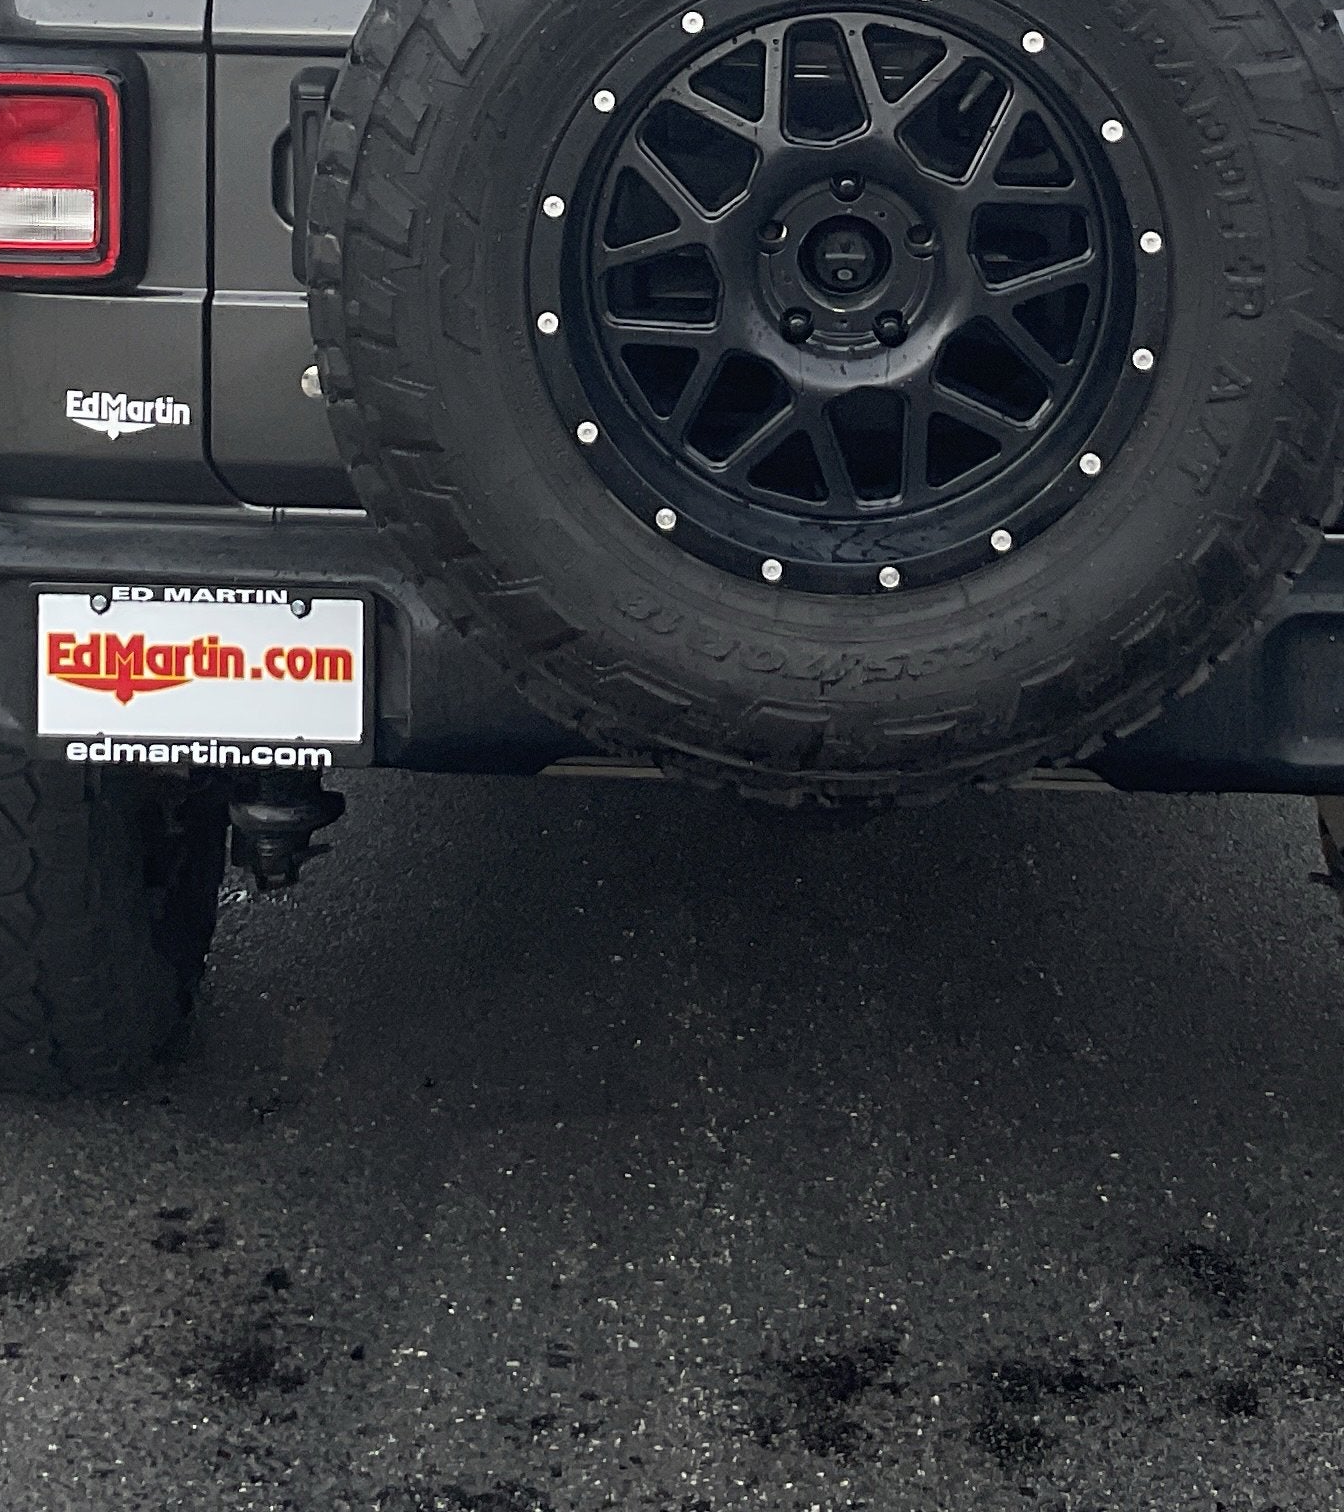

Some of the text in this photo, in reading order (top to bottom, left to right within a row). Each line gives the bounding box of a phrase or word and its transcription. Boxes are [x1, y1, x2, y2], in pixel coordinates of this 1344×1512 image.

[65, 389, 191, 427] EdMartin
[112, 586, 288, 605] ED MARTIN
[47, 632, 354, 683] EdMartin.com
[66, 738, 333, 767] edmartin.com
